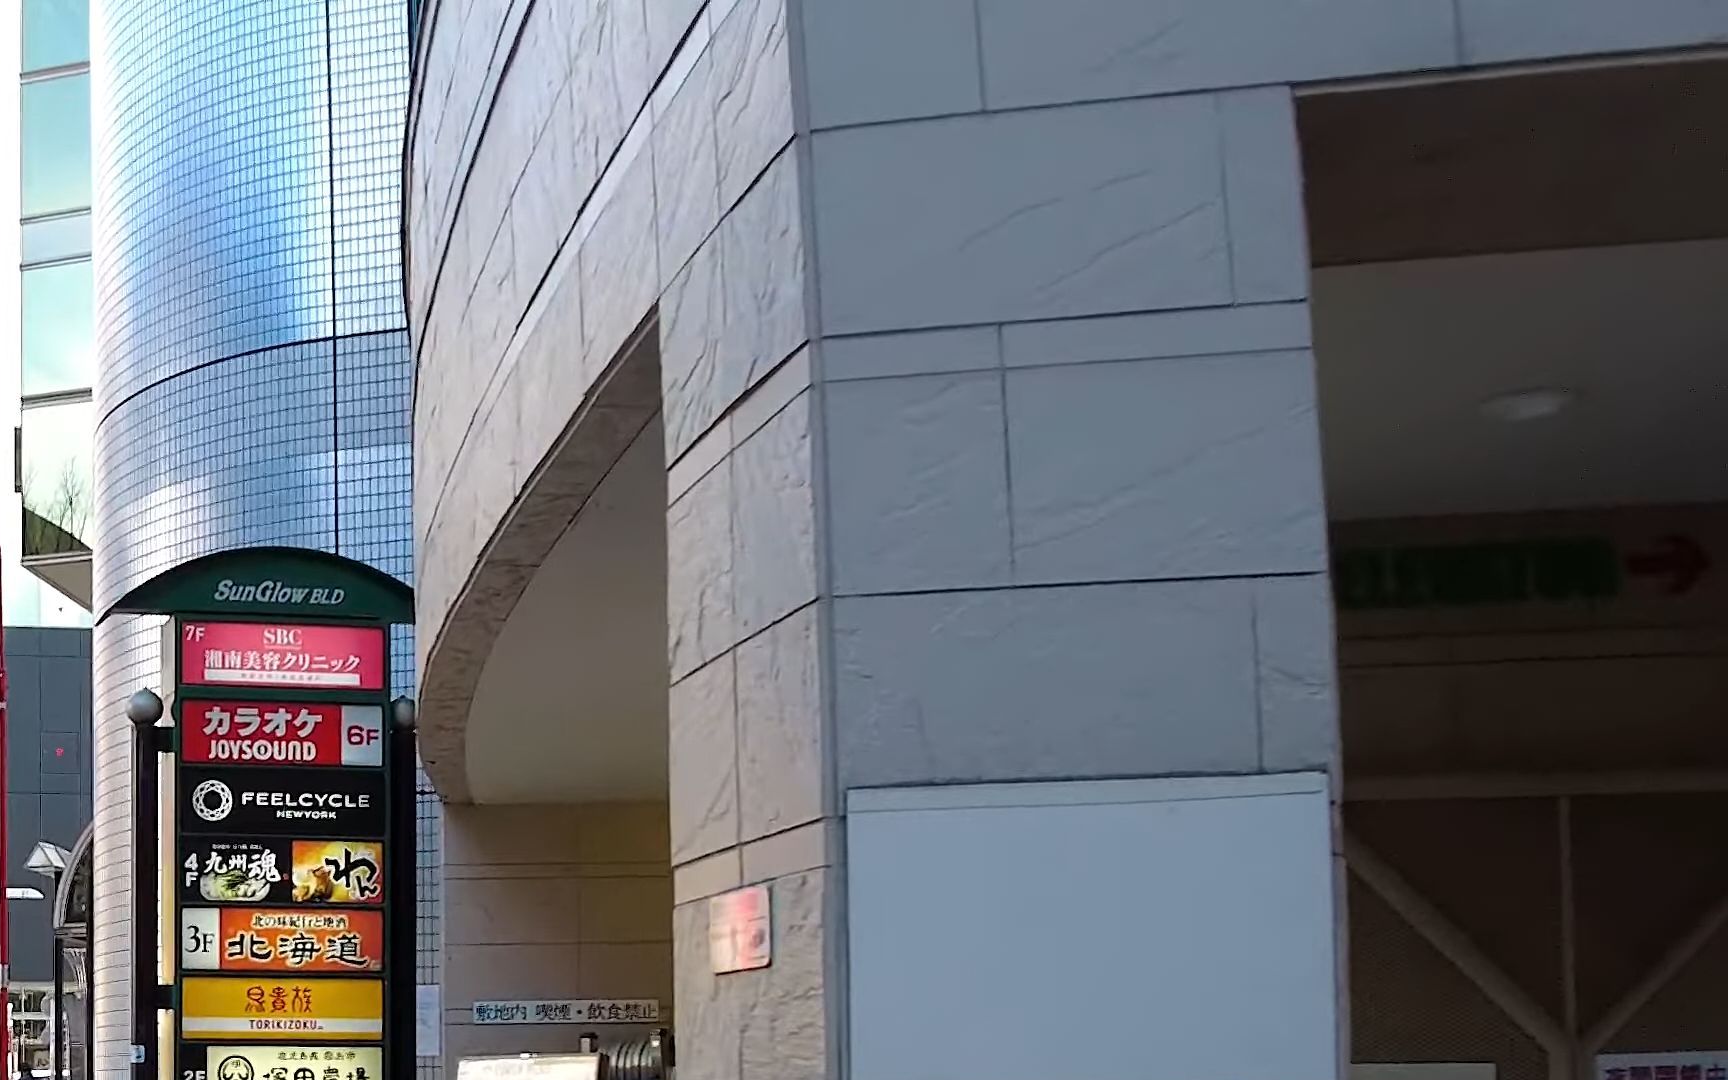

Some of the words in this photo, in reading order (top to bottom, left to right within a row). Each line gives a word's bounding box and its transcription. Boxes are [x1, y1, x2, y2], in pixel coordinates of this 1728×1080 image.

[214, 579, 309, 603] SunGlow
[309, 588, 345, 605] BLD
[185, 625, 205, 642] 7F
[263, 628, 303, 645] SBC
[204, 649, 360, 672] 湘南美容クリニック
[203, 706, 323, 738] カラオケ
[346, 724, 379, 746] 6F
[208, 739, 317, 761] JOYSOUND
[241, 792, 370, 808] FEELCYCLE
[203, 849, 282, 882] 九州魂
[184, 925, 215, 953] 3F
[228, 932, 369, 966] 北海道
[476, 1003, 527, 1021] 敷地内
[249, 1020, 317, 1030] TORIKIZOKU
